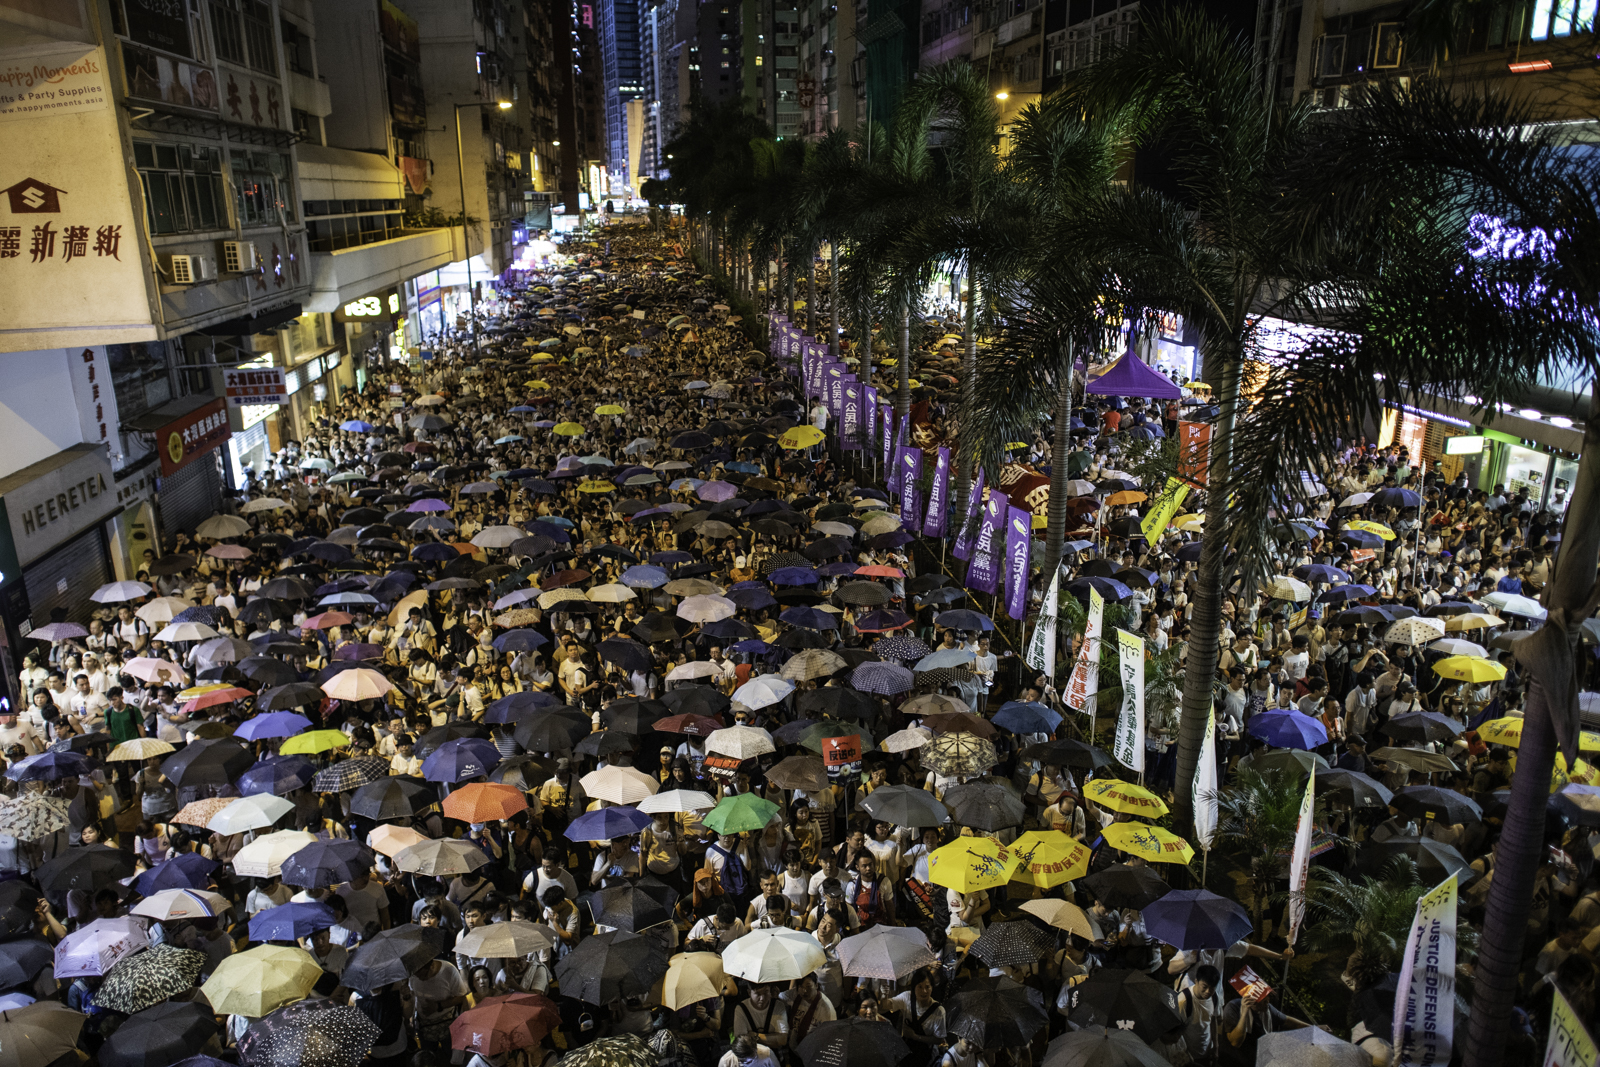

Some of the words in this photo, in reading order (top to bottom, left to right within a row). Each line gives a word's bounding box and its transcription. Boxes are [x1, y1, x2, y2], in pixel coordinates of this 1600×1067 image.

[28, 91, 55, 100] Party
[58, 85, 102, 97] Supplies
[22, 473, 107, 535] HEERETEA
[828, 746, 857, 763] 反送中
[1426, 918, 1440, 974] JUSTICE
